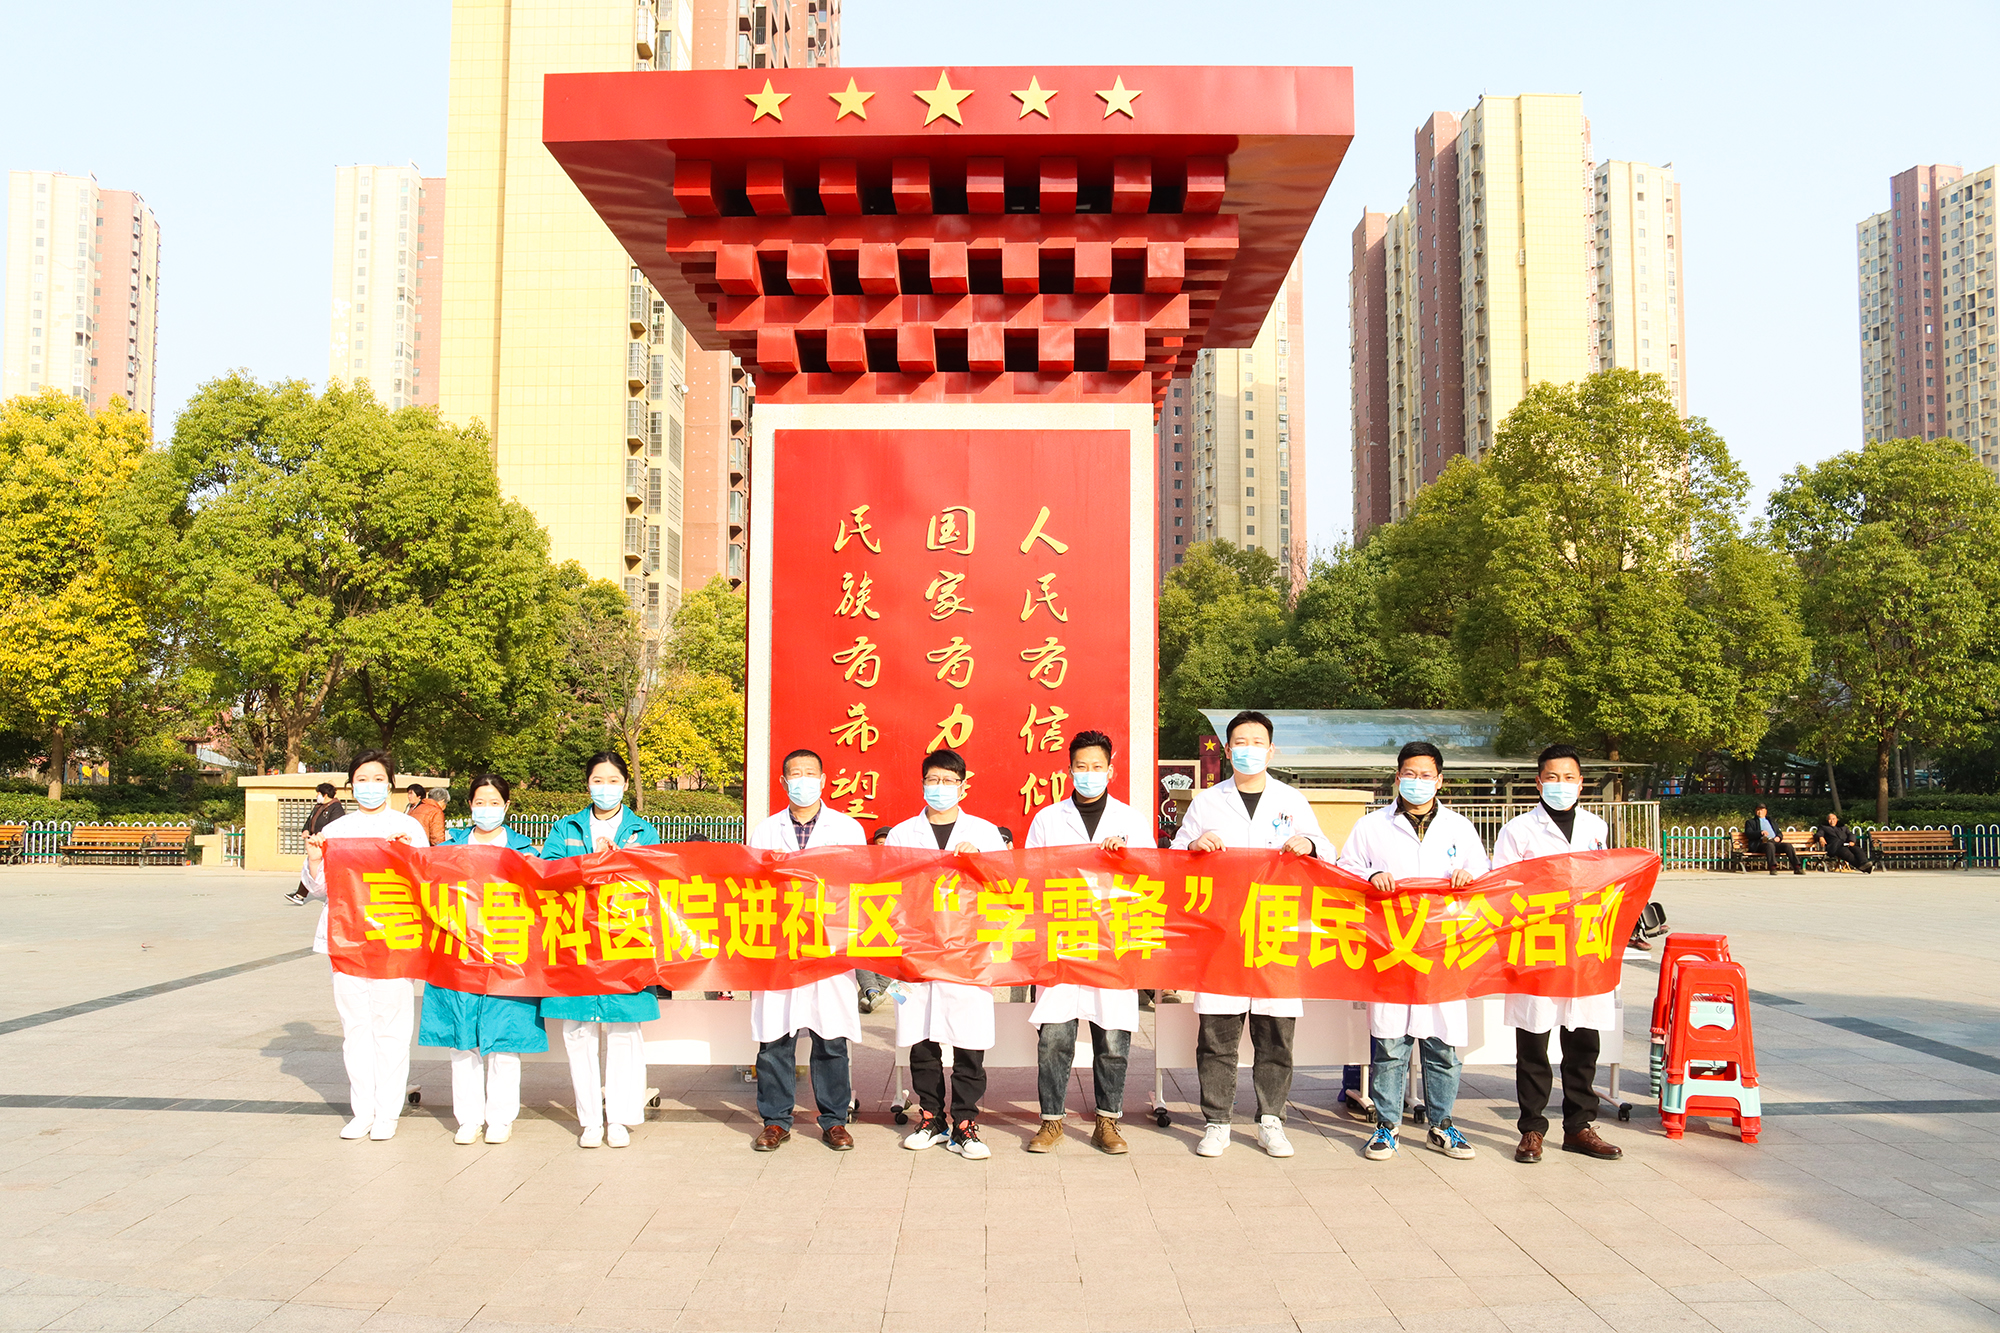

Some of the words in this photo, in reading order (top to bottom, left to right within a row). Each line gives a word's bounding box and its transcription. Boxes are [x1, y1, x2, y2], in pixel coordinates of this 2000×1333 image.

[831, 504, 882, 820] 民族有希望
[925, 505, 976, 802] 国家有力
[1020, 506, 1069, 815] 人民有信仰
